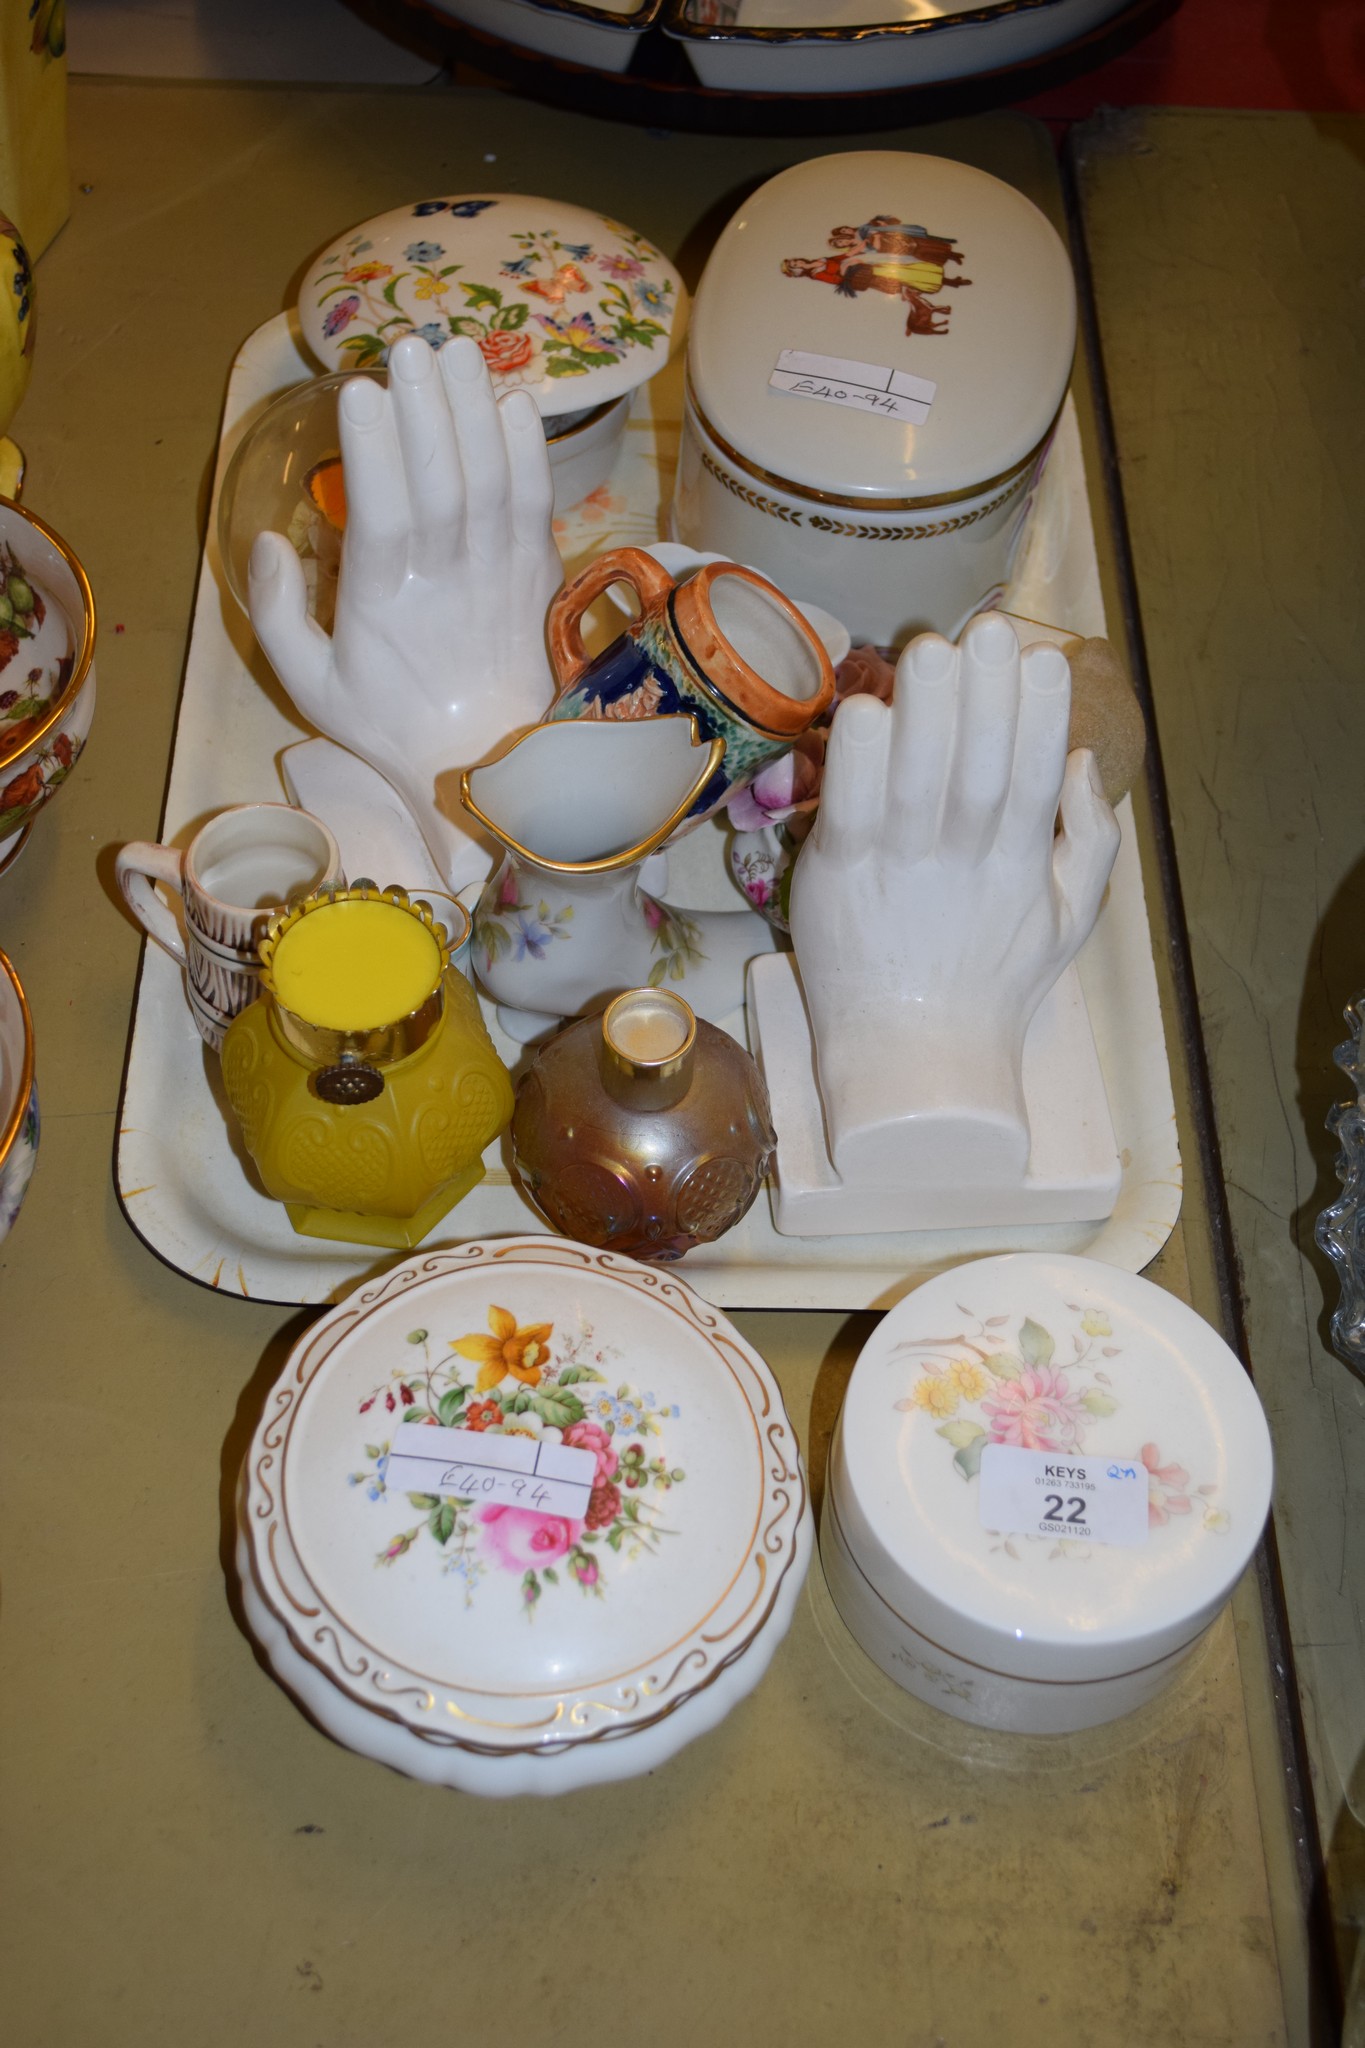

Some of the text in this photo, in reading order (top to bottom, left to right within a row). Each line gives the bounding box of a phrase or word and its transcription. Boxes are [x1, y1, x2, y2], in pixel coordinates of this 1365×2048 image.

[1044, 1465, 1087, 1480] KEYS
[1034, 1477, 1096, 1492] 01263 733195
[1043, 1494, 1087, 1525] 22
[1038, 1521, 1091, 1536] GS021120
